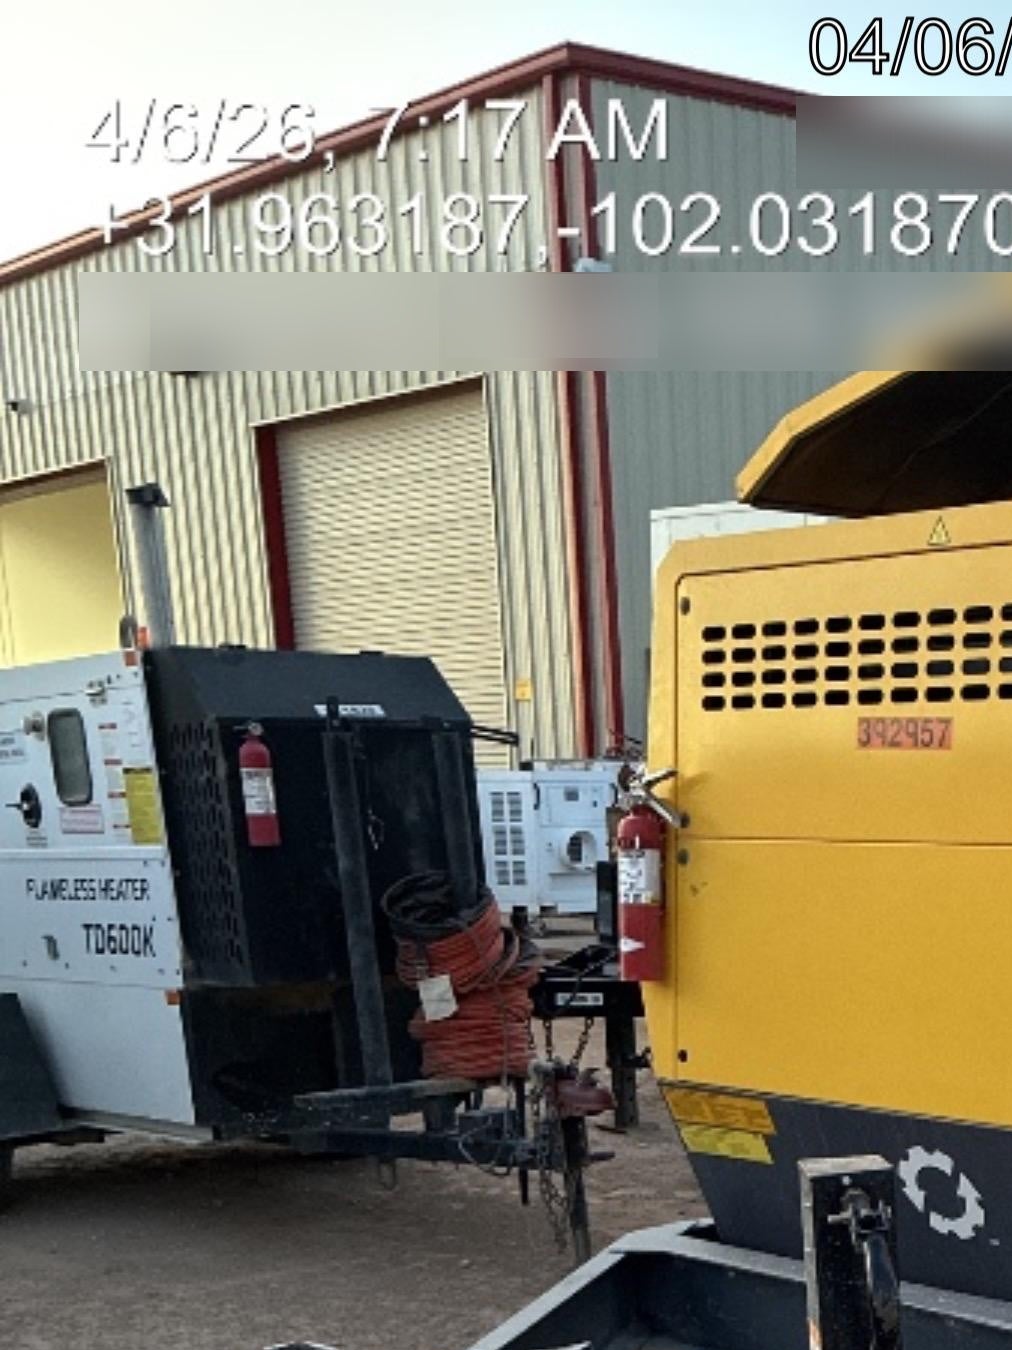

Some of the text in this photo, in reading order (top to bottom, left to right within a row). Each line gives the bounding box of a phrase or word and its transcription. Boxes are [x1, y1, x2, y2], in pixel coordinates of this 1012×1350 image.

[858, 717, 953, 748] 392957
[26, 878, 151, 901] FLAMELESS HEATER
[82, 922, 157, 958] TD600K
